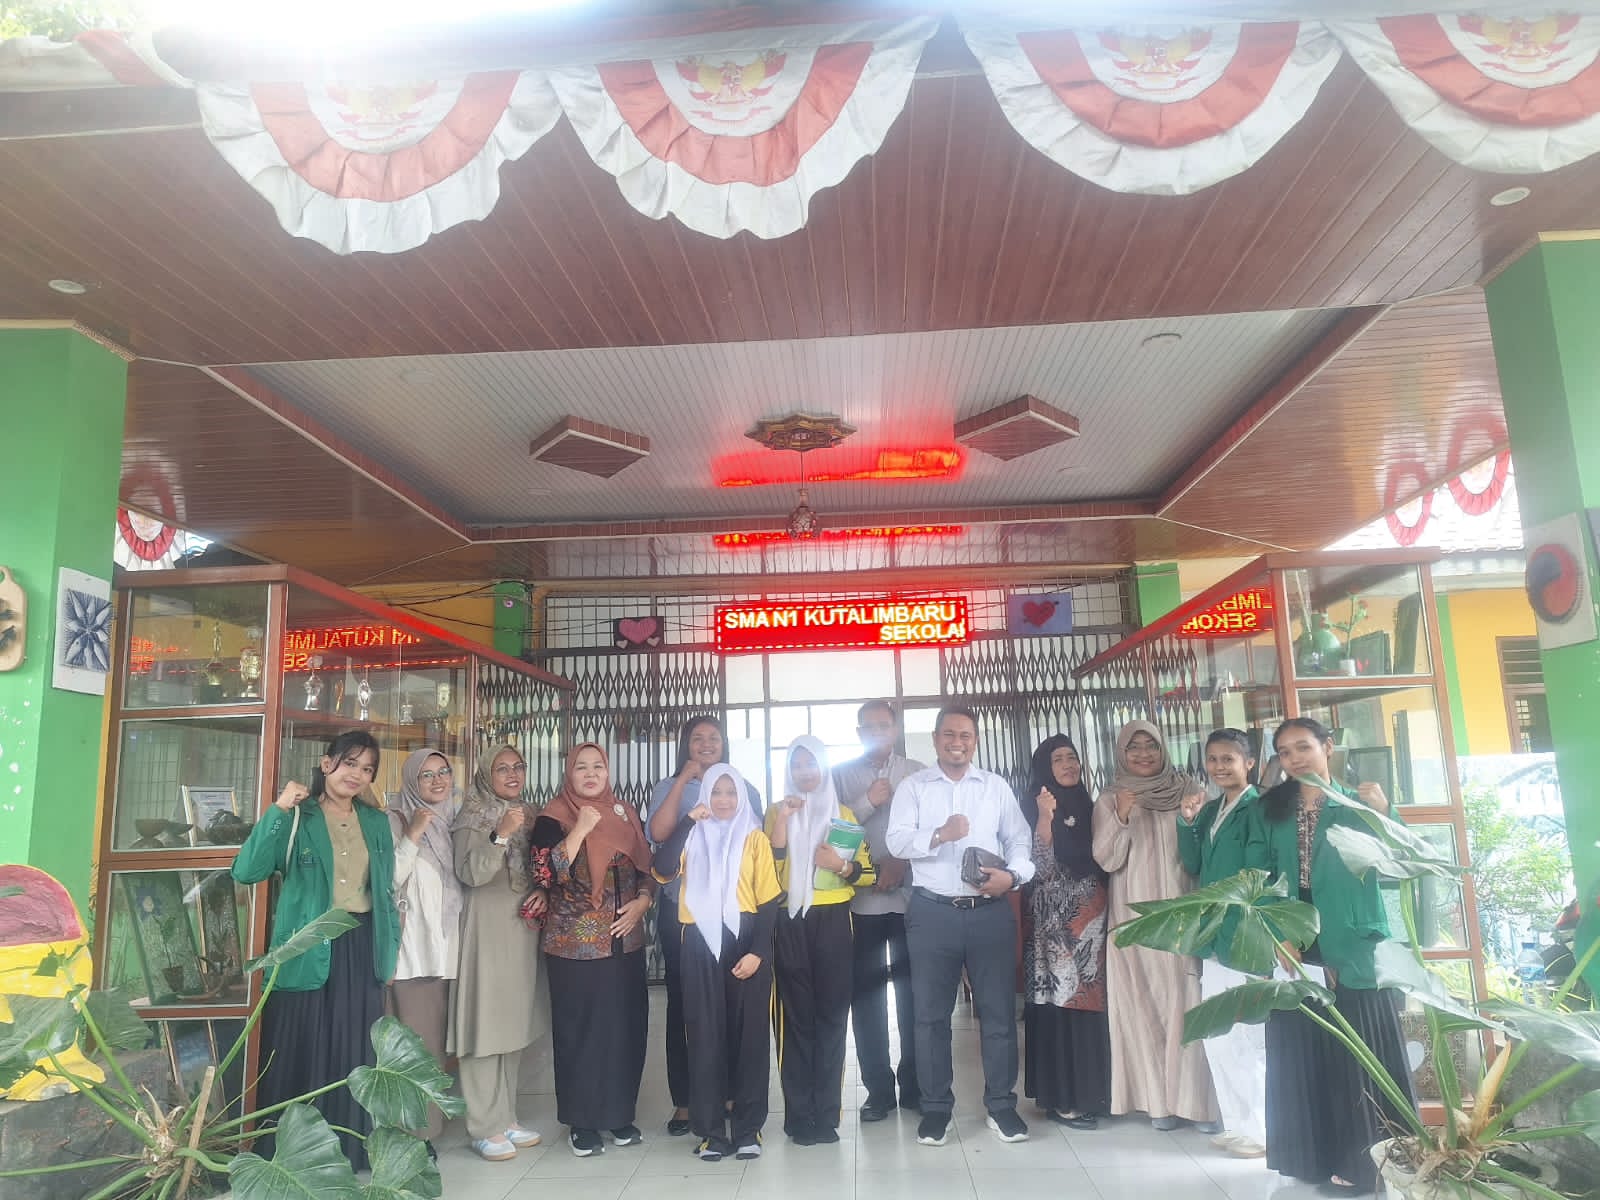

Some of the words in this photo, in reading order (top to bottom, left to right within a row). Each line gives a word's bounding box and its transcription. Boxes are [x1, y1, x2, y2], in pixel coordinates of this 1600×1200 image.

[725, 610, 770, 629] SMA
[772, 605, 797, 627] N1
[804, 603, 956, 626] KUTALIMBARU
